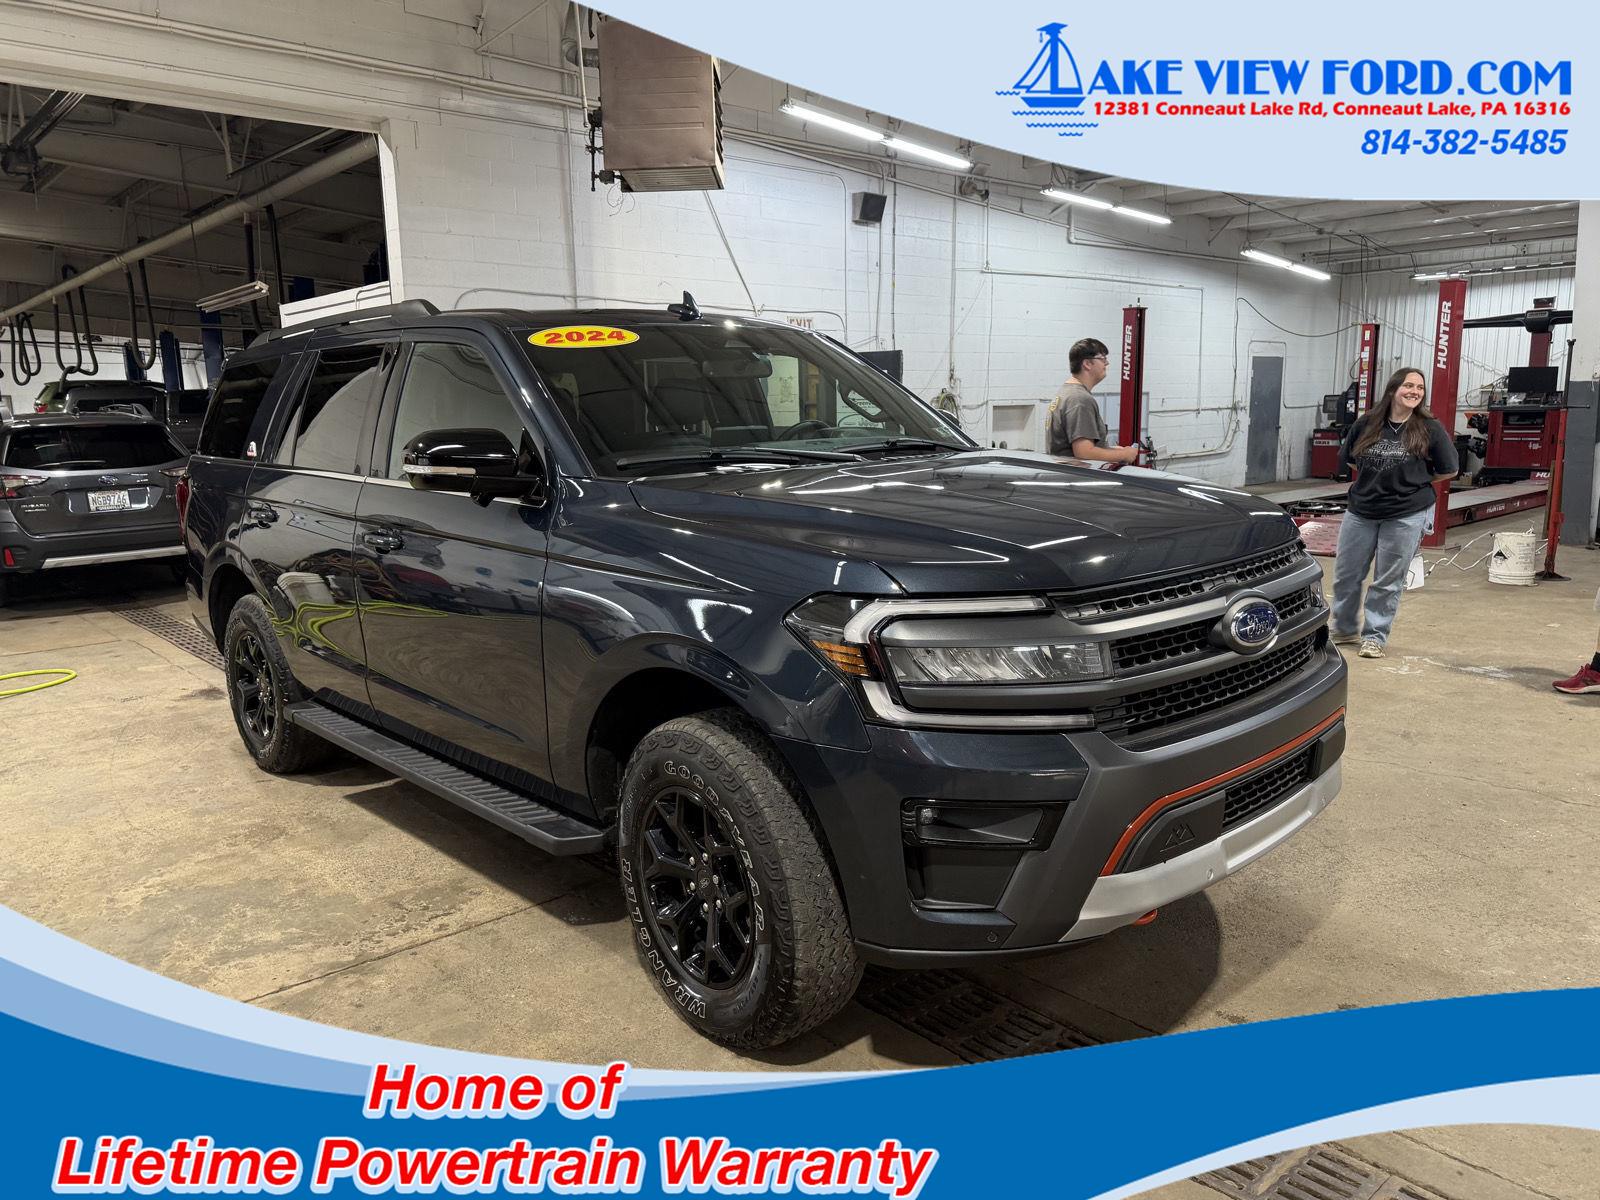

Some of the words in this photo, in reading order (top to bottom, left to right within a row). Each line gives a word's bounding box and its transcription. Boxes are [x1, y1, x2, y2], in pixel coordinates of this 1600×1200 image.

[543, 330, 625, 344] 2024
[1122, 324, 1133, 381] HUNTER
[1437, 300, 1452, 369] HUNTER
[1240, 612, 1274, 639] Ford
[663, 760, 765, 936] GOODYEAR
[622, 858, 707, 1019] WRANGLER
